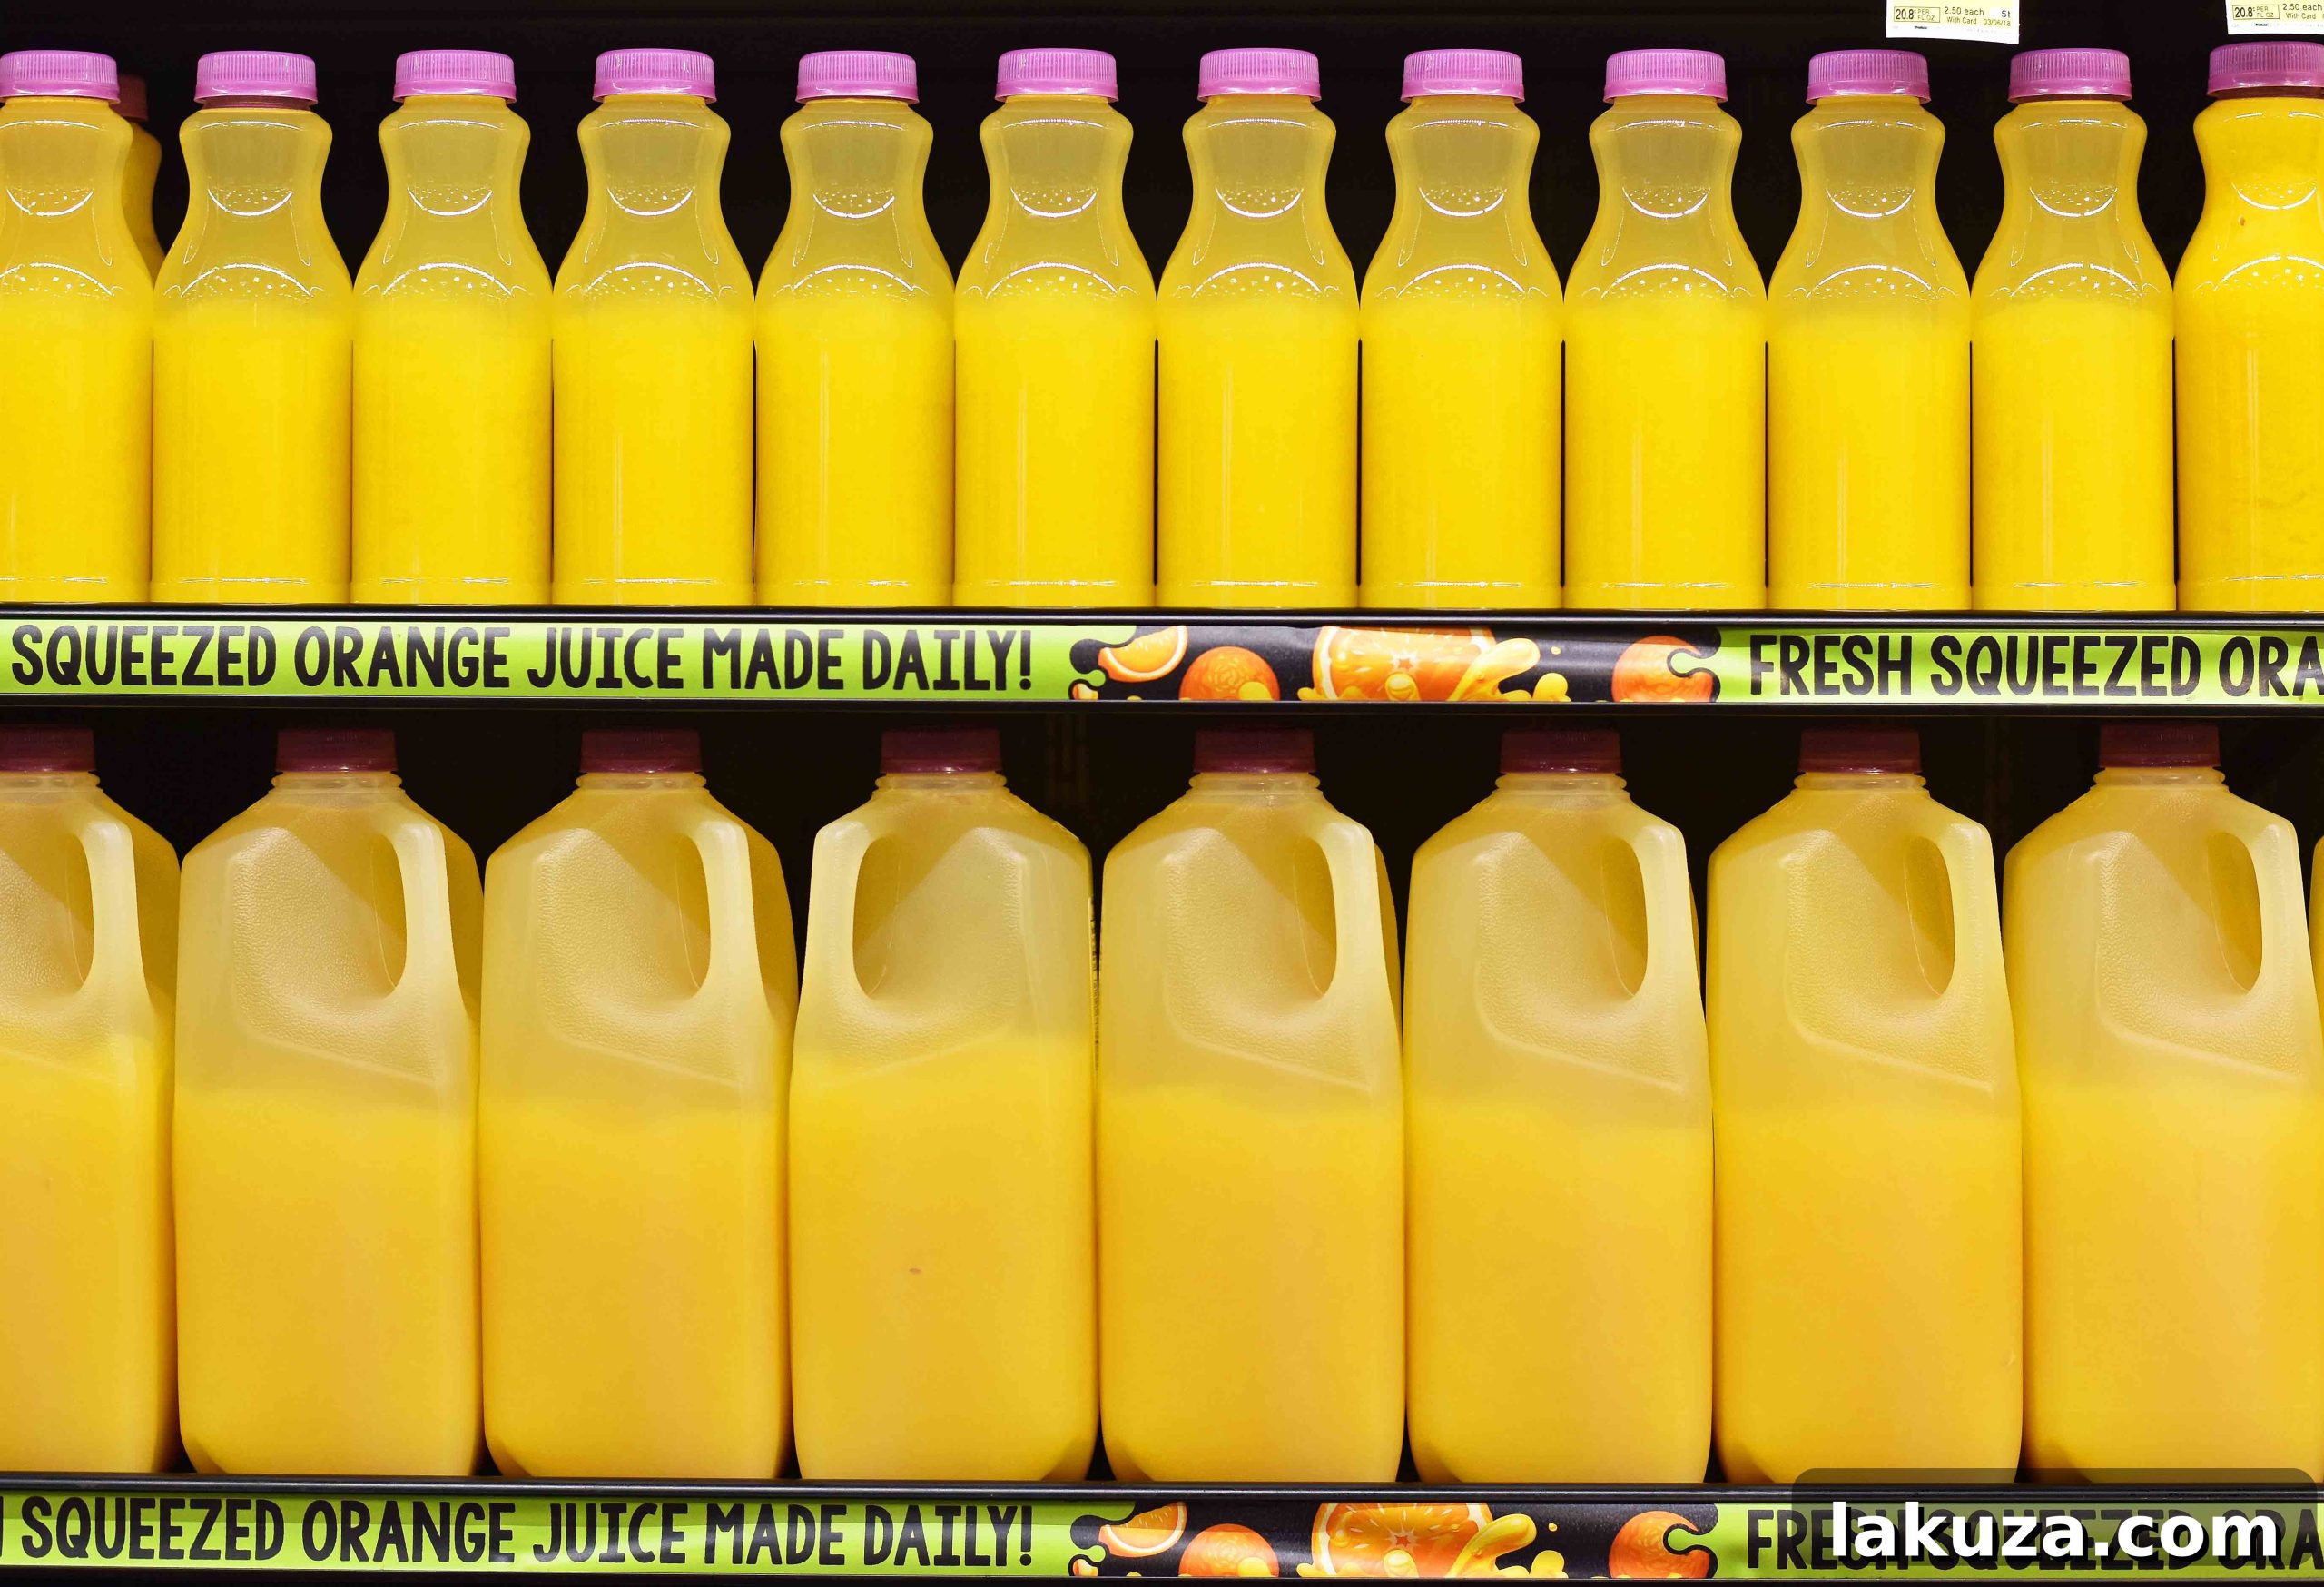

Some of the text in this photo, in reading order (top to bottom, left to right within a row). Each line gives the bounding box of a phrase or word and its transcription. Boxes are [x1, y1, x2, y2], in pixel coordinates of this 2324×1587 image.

[1944, 6, 1984, 16] 2.50 each
[2282, 3, 2300, 11] 2.50
[12, 625, 1032, 691] SQUEEZED ORANGE JUICE MADE DAILY!
[1749, 635, 2324, 697] FRESH SQUEEZED ORA
[22, 1495, 285, 1561] SQUEEZED
[302, 1500, 516, 1563] ORANGE
[533, 1503, 688, 1564] JUICE
[704, 1503, 847, 1566] MADE
[863, 1504, 1032, 1567] DAILY!
